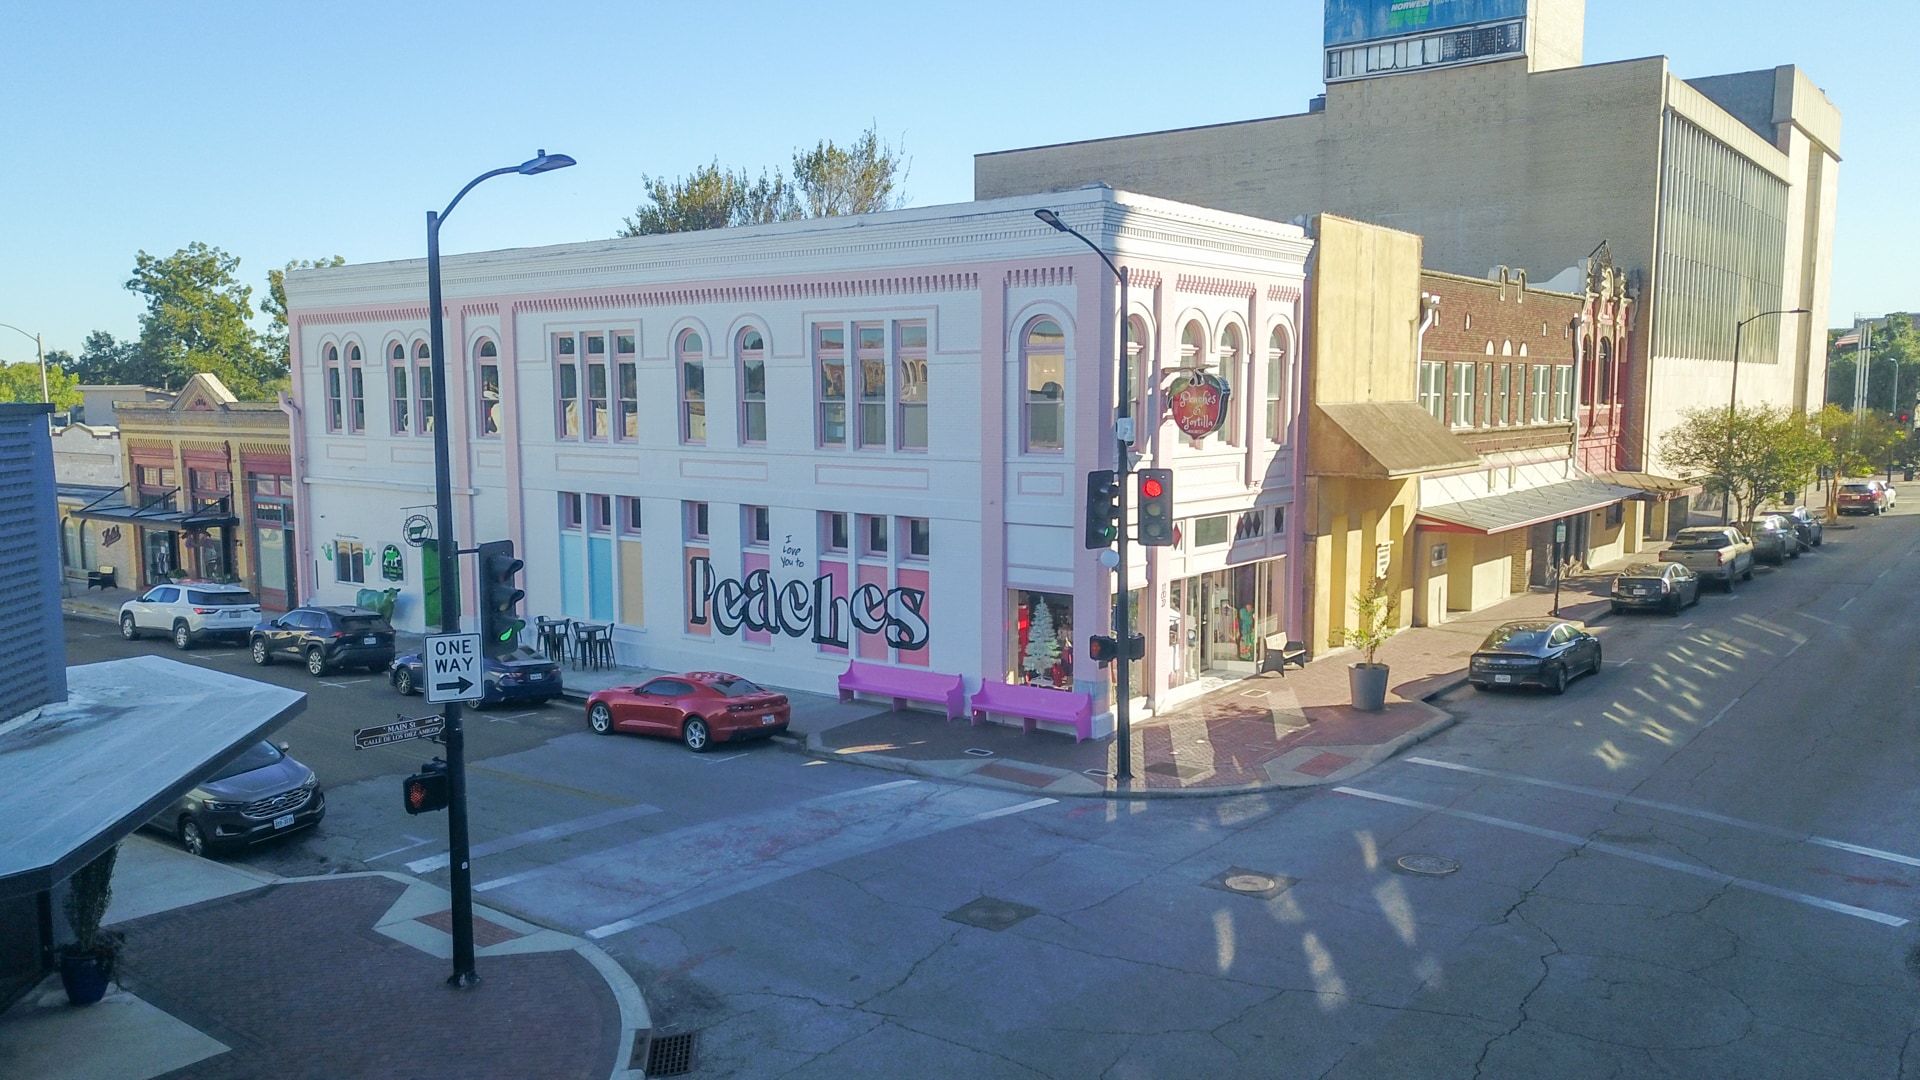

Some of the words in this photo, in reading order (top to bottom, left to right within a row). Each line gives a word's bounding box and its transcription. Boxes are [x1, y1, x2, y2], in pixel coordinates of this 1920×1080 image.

[1391, 0, 1430, 12] NORWEST
[1180, 390, 1216, 407] Peaches
[1181, 415, 1213, 430] Tortilla
[785, 535, 792, 544] I
[780, 556, 793, 568] You
[795, 557, 804, 567] to
[690, 557, 929, 650] Peaches
[436, 640, 472, 655] ONE
[435, 657, 473, 673] WAY
[387, 723, 407, 732] MAIN
[363, 737, 381, 746] CALLE
[383, 735, 390, 743] DE
[392, 733, 404, 741] LOS
[404, 731, 417, 739] DIEZ
[419, 726, 439, 736] AMIGOS
